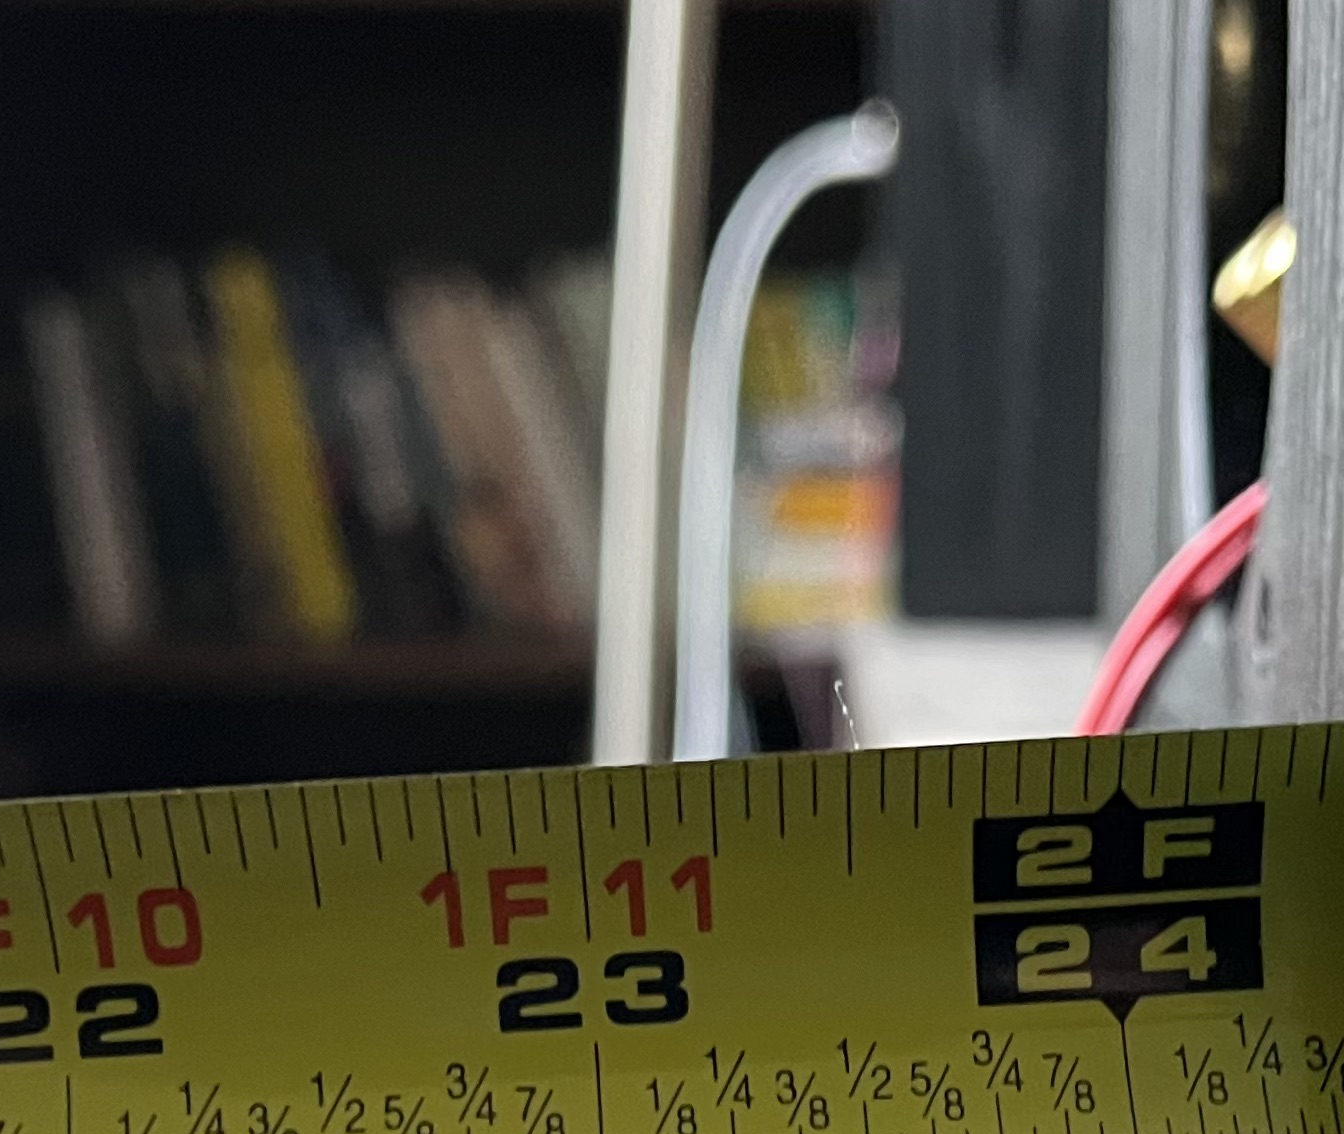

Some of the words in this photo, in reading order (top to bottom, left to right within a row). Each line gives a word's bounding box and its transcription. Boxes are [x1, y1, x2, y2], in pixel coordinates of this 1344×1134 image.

[66, 887, 204, 970] 10
[420, 866, 550, 949] 1F
[604, 856, 714, 938] 11
[495, 950, 691, 1034] 23
[1015, 914, 1218, 994] 24
